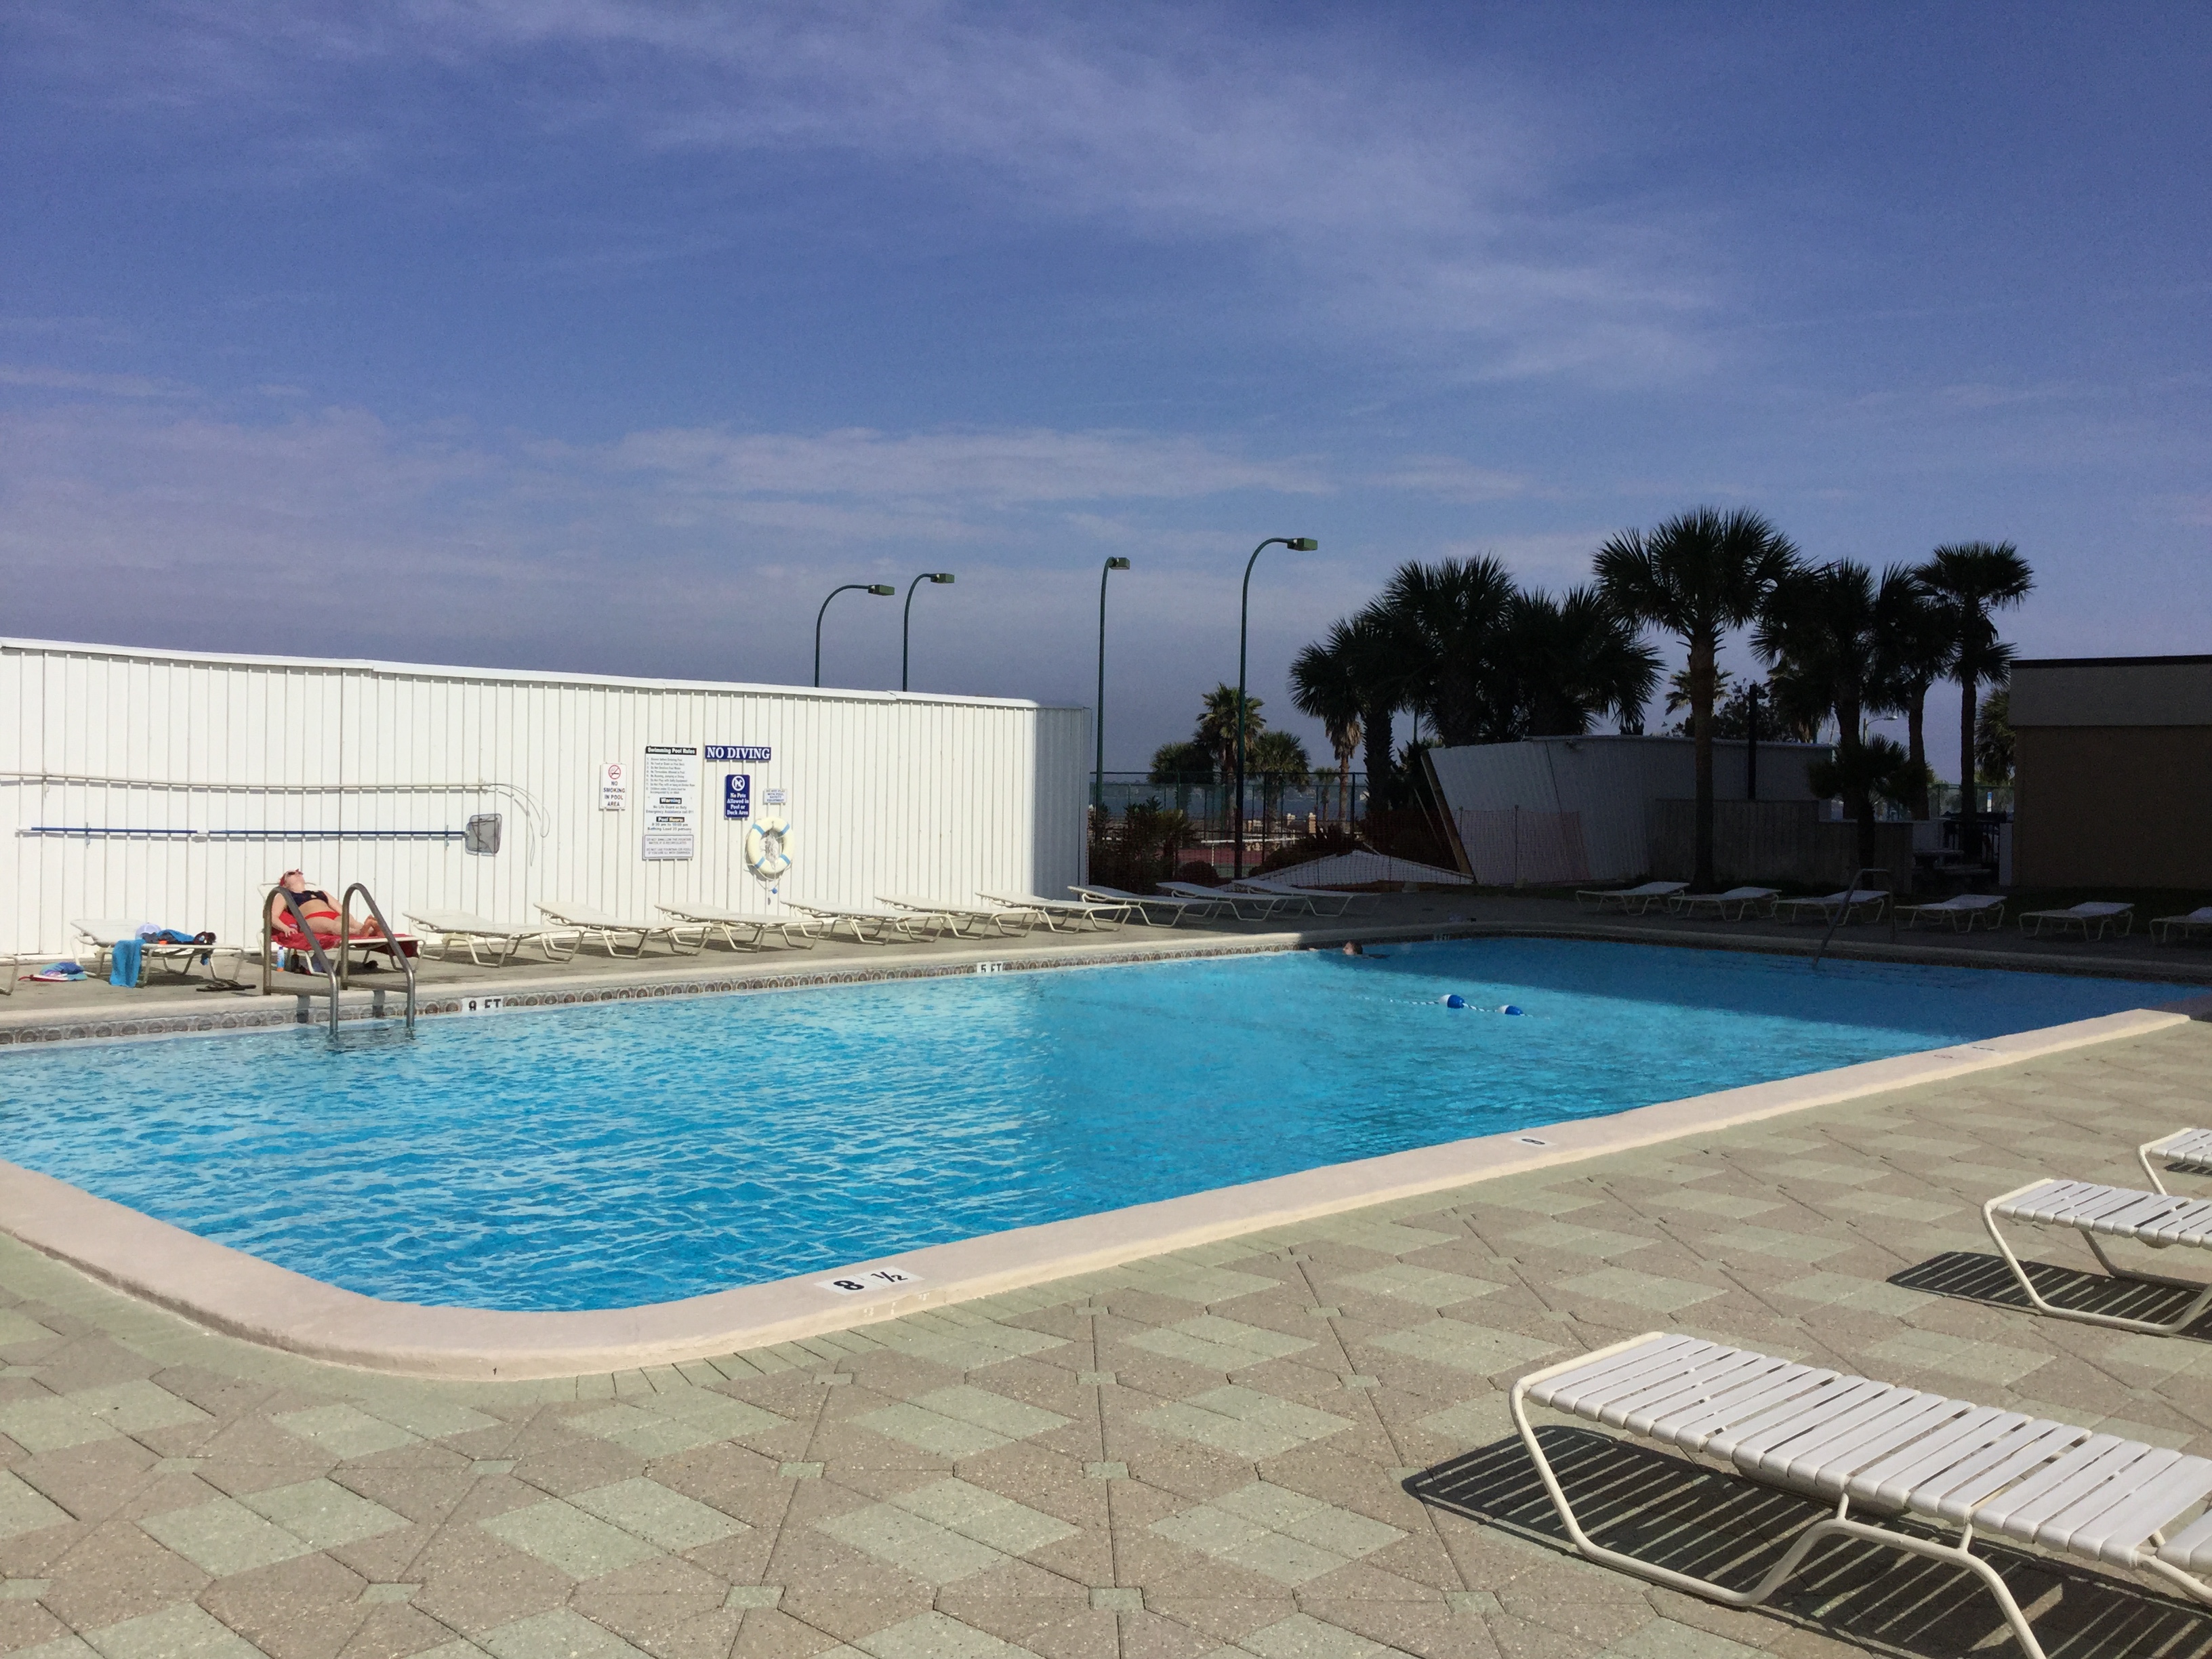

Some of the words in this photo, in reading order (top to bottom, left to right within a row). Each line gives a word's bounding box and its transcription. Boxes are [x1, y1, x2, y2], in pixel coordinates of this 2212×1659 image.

[706, 747, 724, 758] NO
[726, 747, 771, 759] DIVING
[981, 964, 987, 972] 5
[990, 963, 1002, 972] FT
[485, 998, 501, 1009] FT
[833, 1280, 865, 1291] 8
